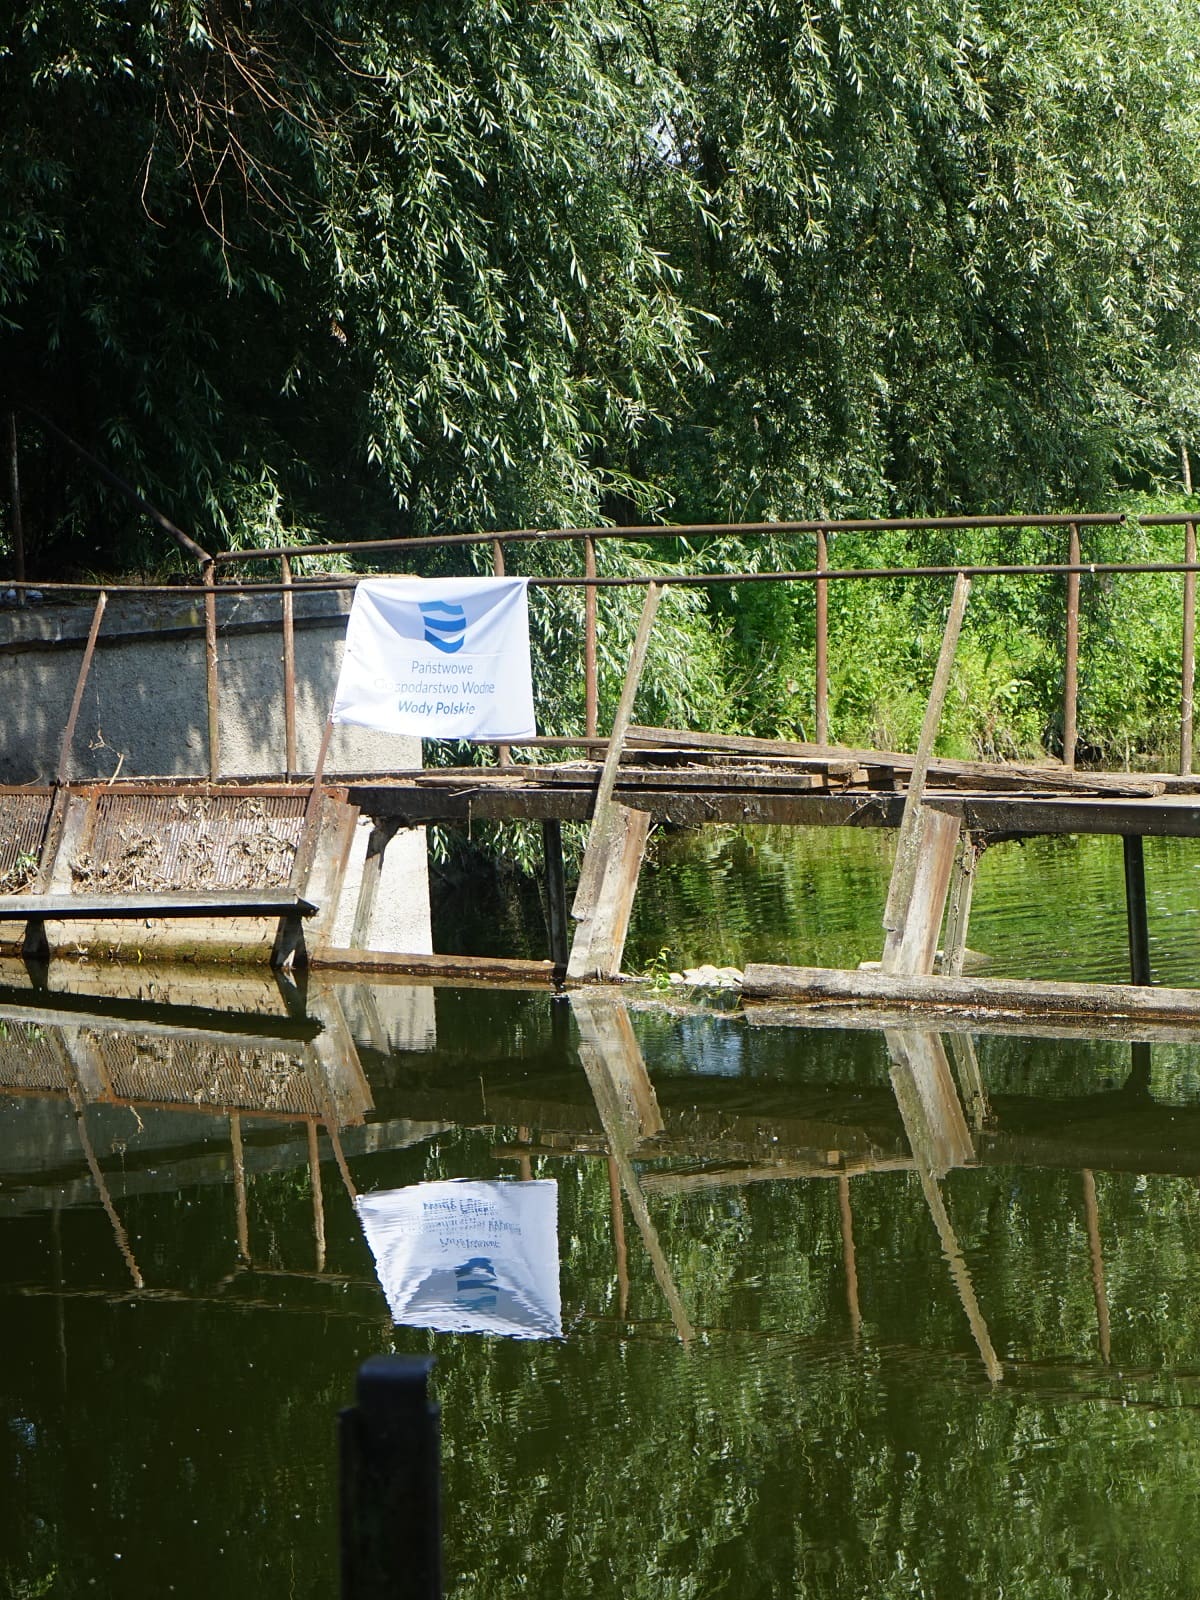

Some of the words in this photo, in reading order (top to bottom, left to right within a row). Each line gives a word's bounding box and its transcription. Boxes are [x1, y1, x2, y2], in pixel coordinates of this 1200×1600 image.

[411, 659, 473, 674] Państwowe
[462, 681, 495, 694] Wodne
[398, 700, 433, 716] Wody
[435, 701, 476, 715] Polskie
